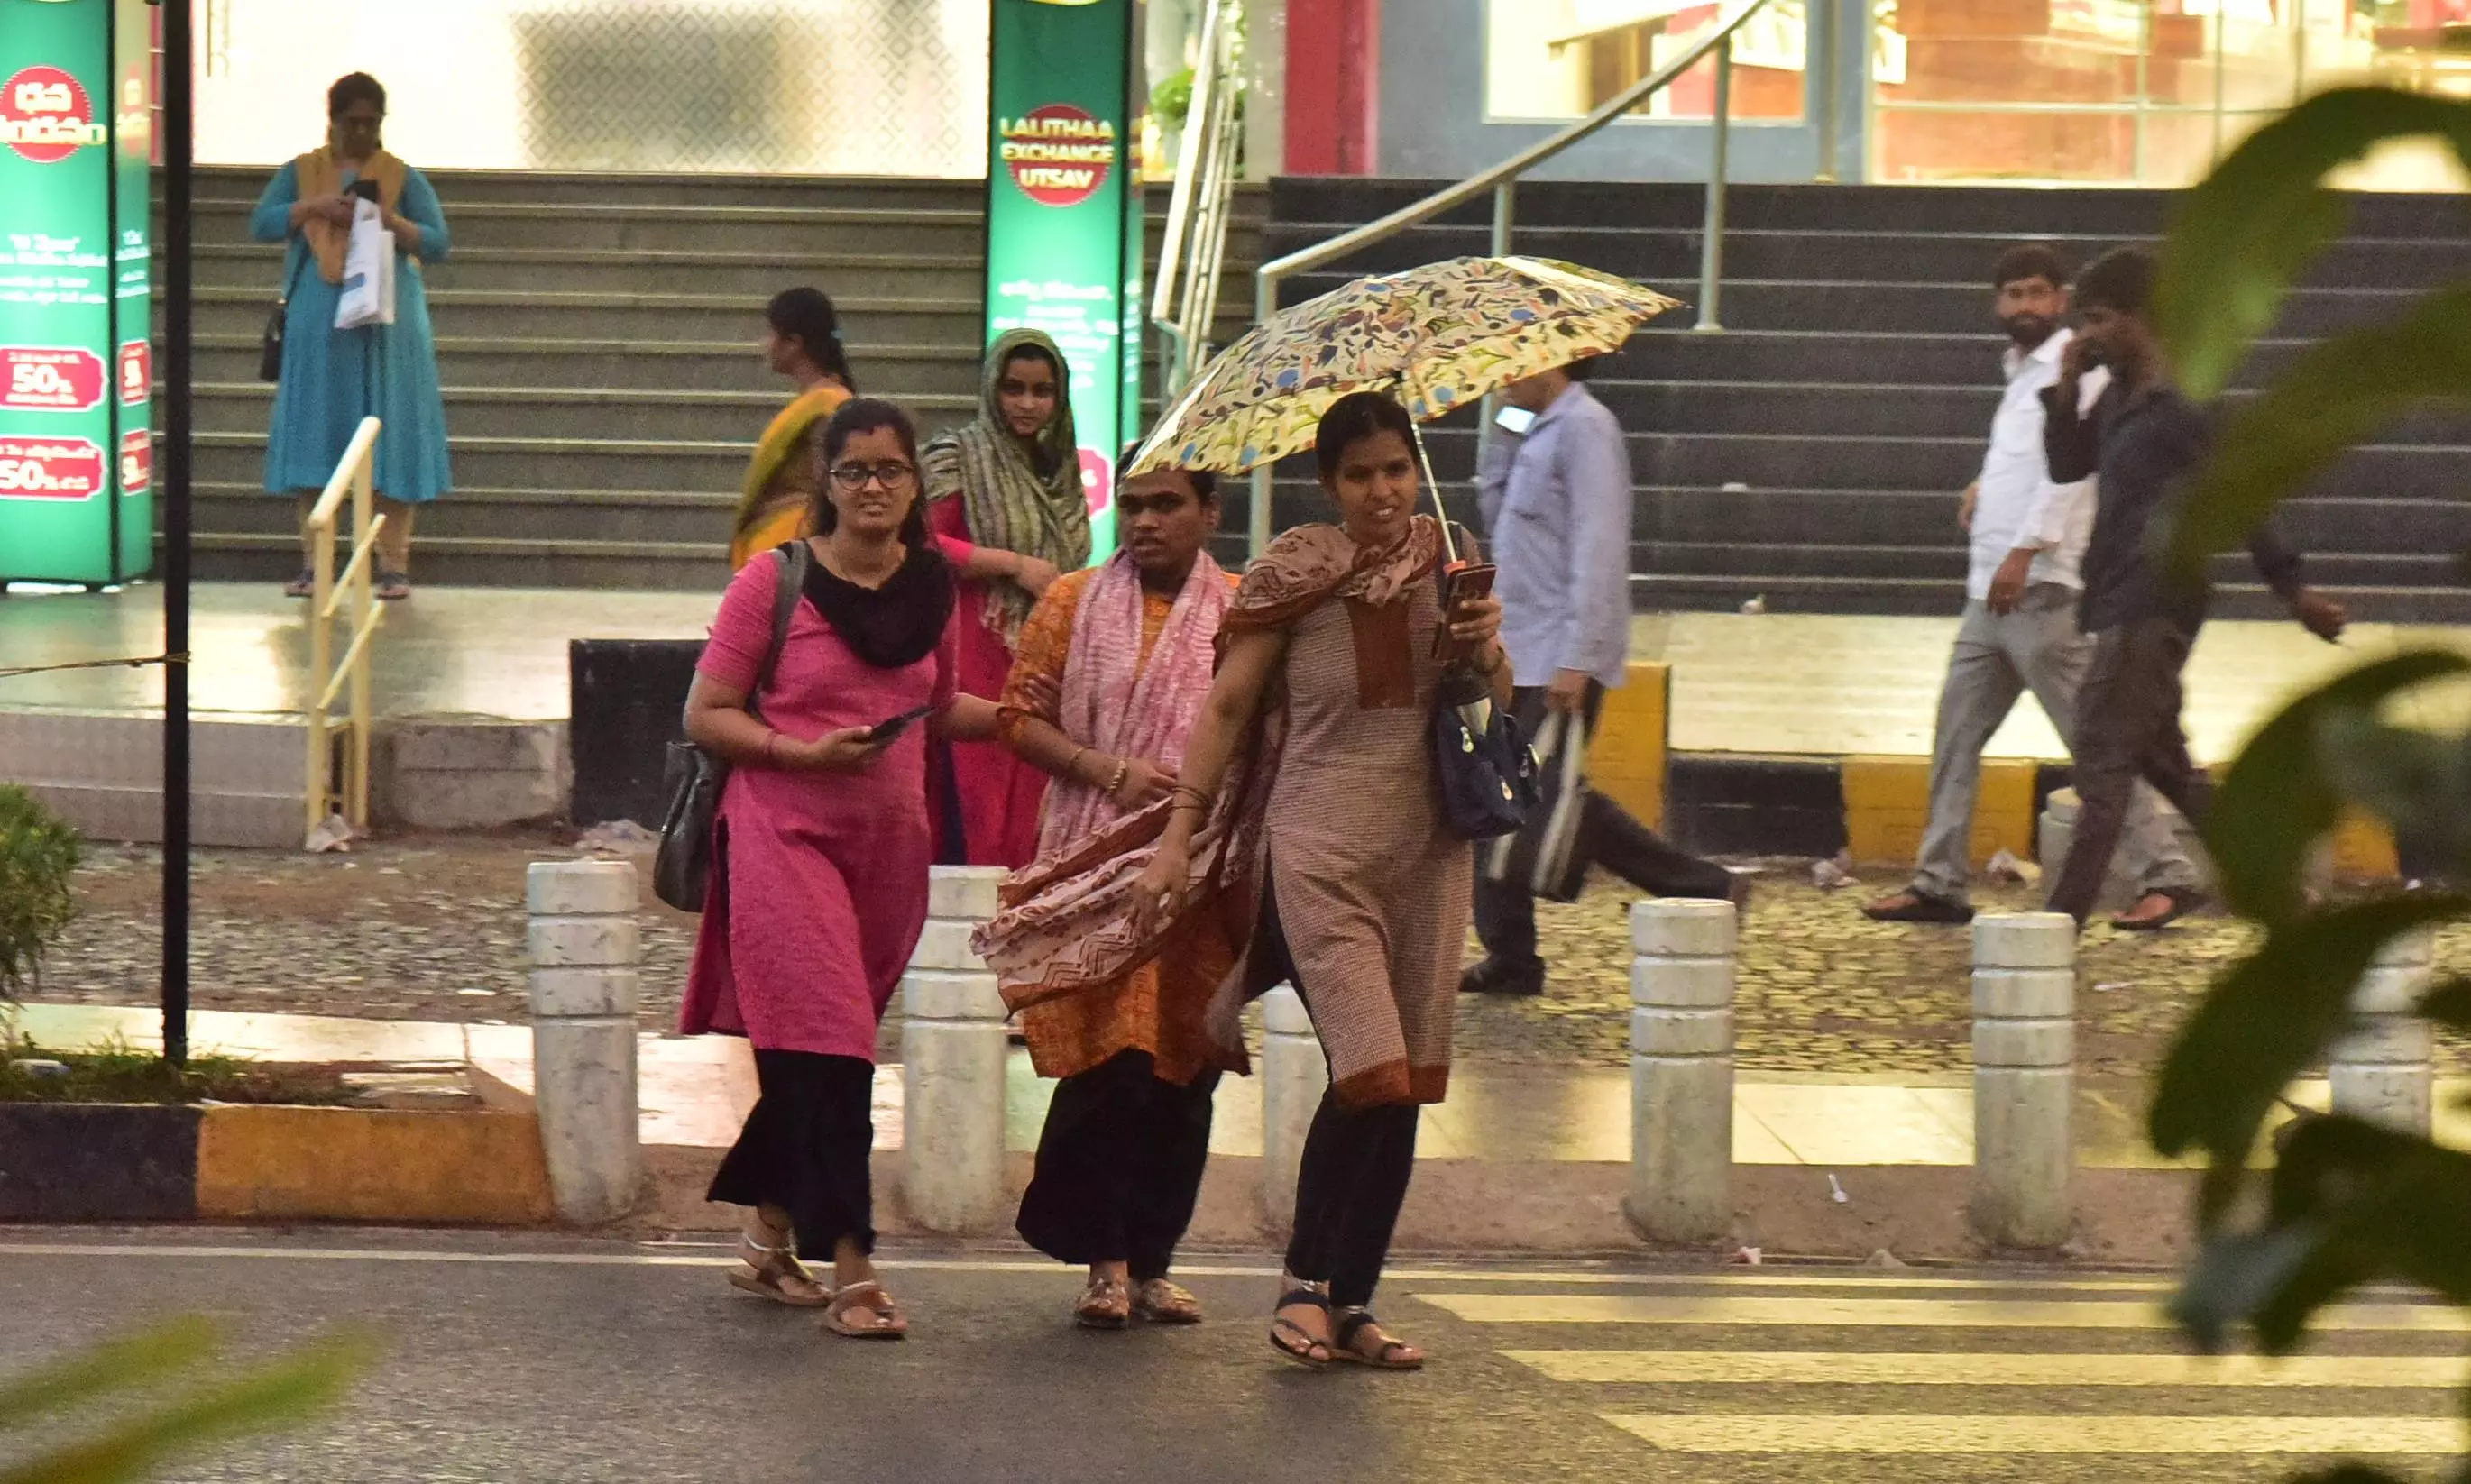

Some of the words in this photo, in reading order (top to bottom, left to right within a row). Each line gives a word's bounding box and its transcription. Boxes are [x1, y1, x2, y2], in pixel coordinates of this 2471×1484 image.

[999, 117, 1116, 139] LALITHAA
[999, 142, 1116, 163] EXCHANGE
[1019, 169, 1095, 188] UTSAV
